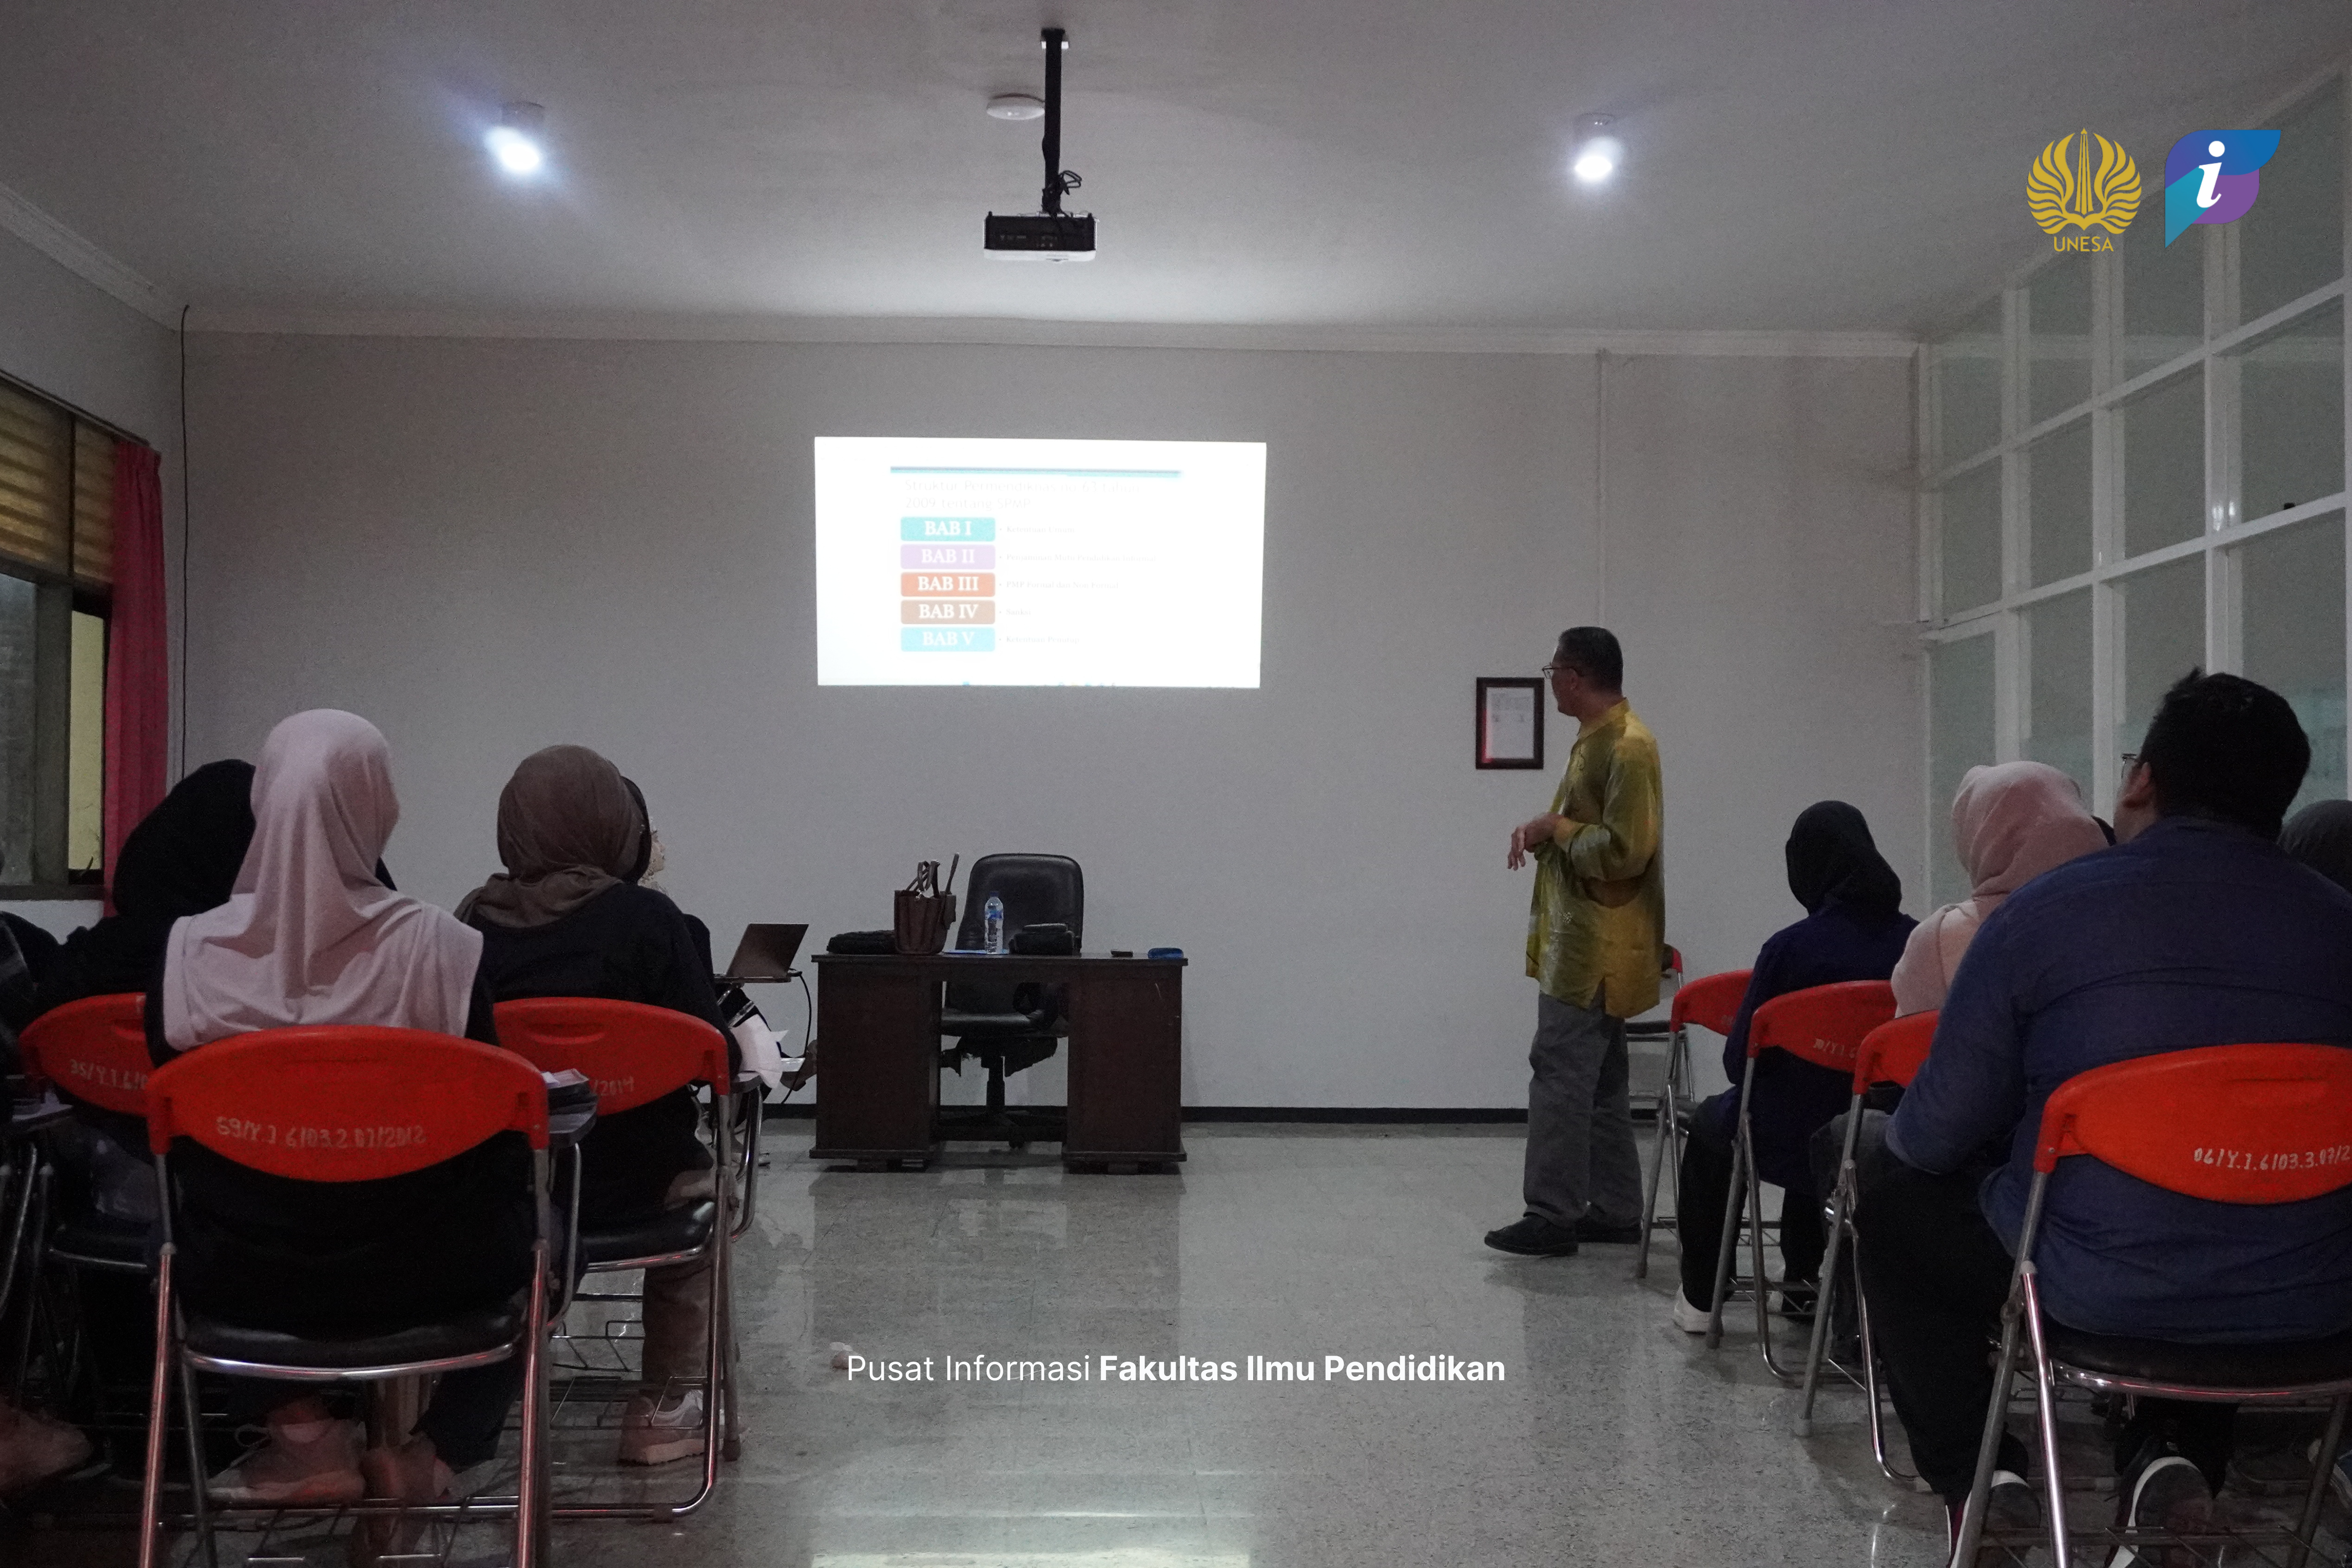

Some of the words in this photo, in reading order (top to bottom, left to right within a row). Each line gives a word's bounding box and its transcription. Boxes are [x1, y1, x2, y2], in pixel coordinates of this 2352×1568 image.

[906, 480, 957, 491] Struktur
[965, 480, 1055, 492] Permendiknas
[1083, 481, 1096, 492] 63
[1102, 480, 1139, 493] tahun
[906, 497, 936, 508] 2009
[942, 498, 992, 511] tentang
[998, 498, 1031, 509] SPMP
[925, 521, 960, 535] BAB
[966, 521, 971, 535] I
[921, 549, 956, 563] BAB
[962, 549, 975, 563] II
[1007, 554, 1052, 562] Penjaminan
[918, 576, 954, 591] BAB
[958, 576, 979, 591] III
[919, 604, 954, 618] BAB
[959, 604, 978, 618] IV
[922, 631, 958, 646] BAB
[961, 631, 974, 646] V
[1048, 636, 1079, 645] Penutup
